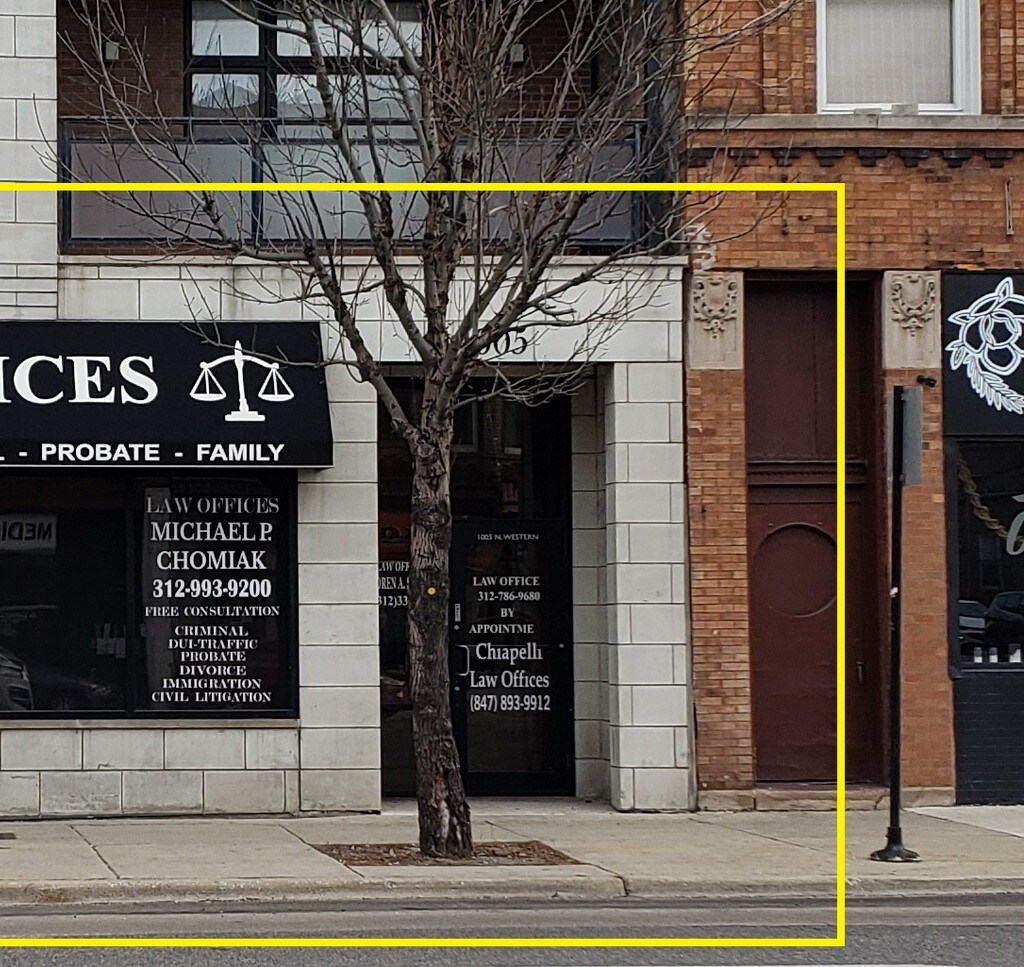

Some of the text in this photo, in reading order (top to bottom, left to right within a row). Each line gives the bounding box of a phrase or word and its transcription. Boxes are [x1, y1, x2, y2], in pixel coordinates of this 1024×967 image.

[41, 442, 160, 461] PROBATE
[196, 443, 285, 462] FAMILY
[146, 497, 280, 514] LAW OFFICES
[150, 521, 273, 541] MICHAEL P.
[156, 550, 268, 570] CHOMIAK
[472, 576, 540, 587] LAW OFFICE
[152, 578, 272, 598] 312-993-9200
[477, 591, 541, 602] 312-786-9680
[145, 606, 280, 617] FREE CONSULTATION
[500, 607, 515, 618] BY
[174, 625, 249, 637] CRIMINAL
[468, 623, 535, 634] APPOINTME
[168, 638, 258, 649] DUI-TRAFFIC
[180, 651, 247, 662] PROBATE
[179, 665, 247, 676] DIVORCE
[162, 678, 262, 689] IMMIGRATION
[469, 669, 550, 688] Law Offices
[151, 691, 272, 703] CIVIL LITIGATION
[470, 694, 551, 713] (847) 893-9912
